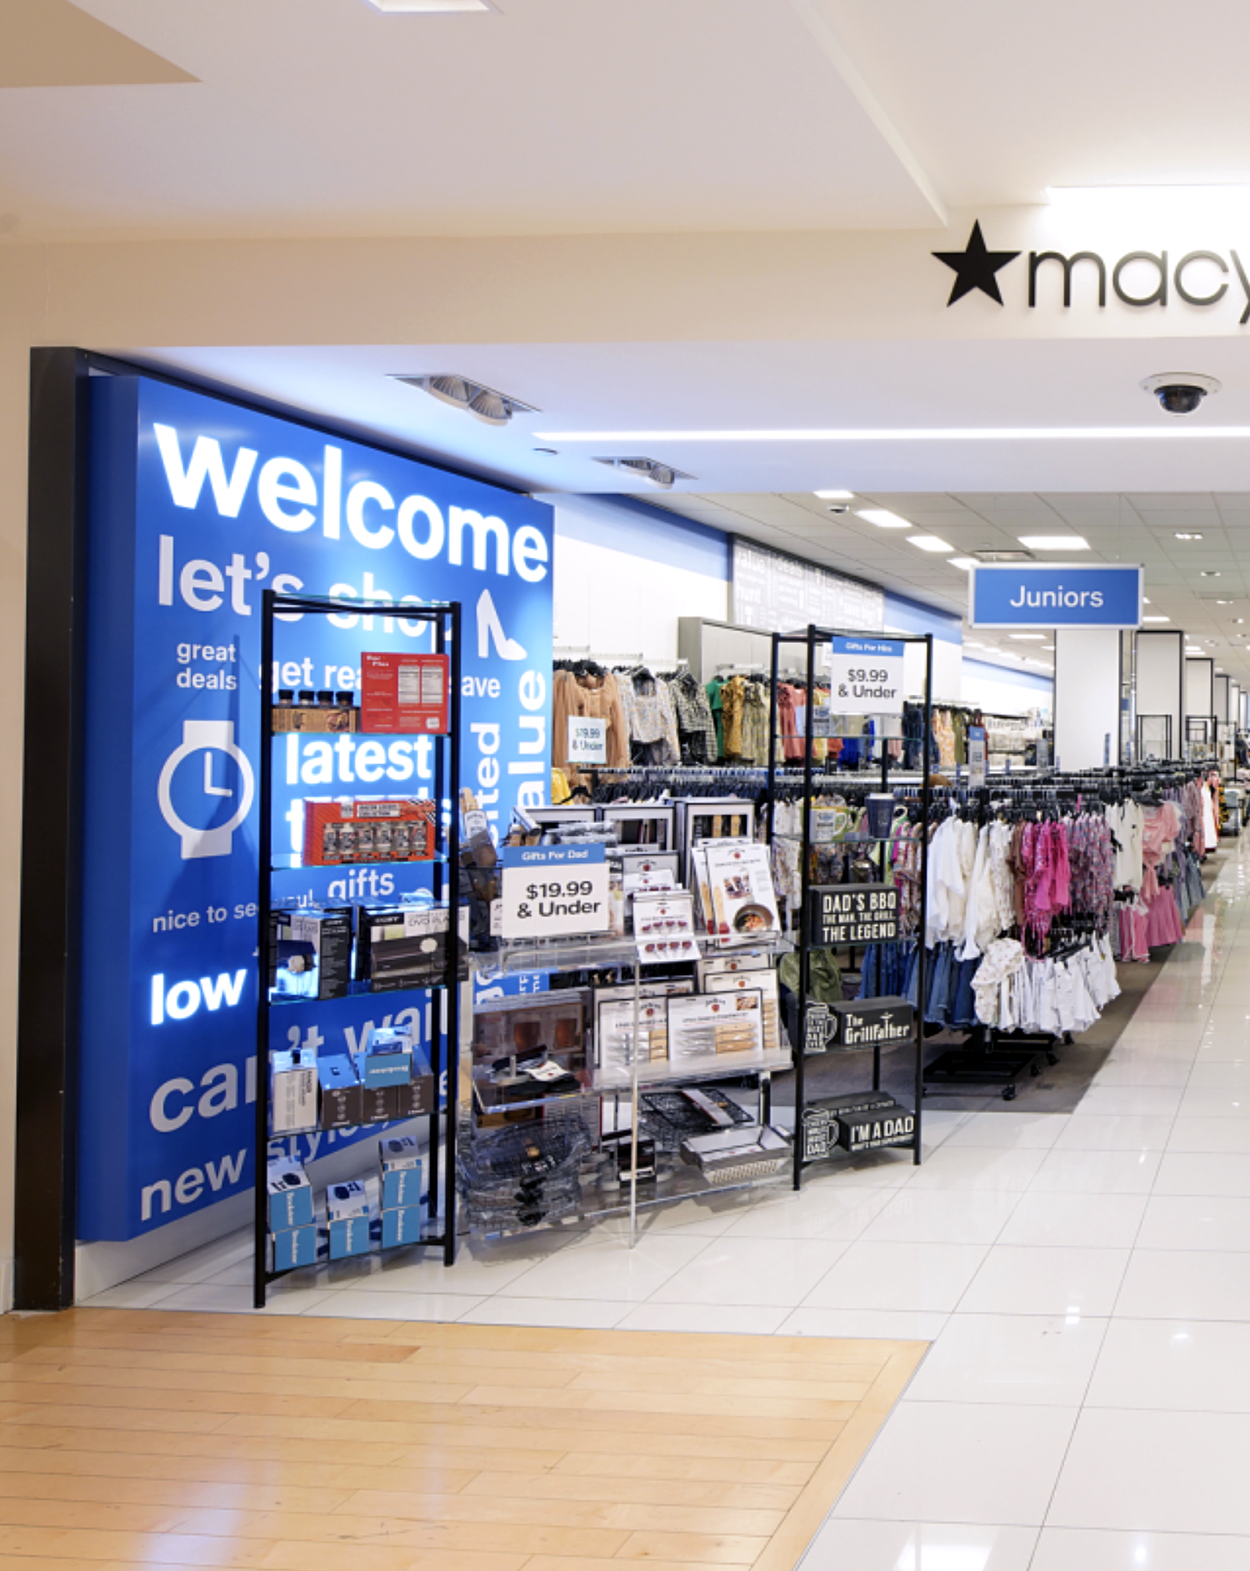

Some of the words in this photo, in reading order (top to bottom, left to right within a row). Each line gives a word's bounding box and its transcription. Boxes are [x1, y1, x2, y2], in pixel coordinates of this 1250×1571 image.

[153, 422, 549, 583] welcome
[1009, 585, 1104, 608] Juniors
[176, 642, 237, 664] great
[864, 643, 876, 651] For
[176, 667, 238, 690] deals
[848, 668, 888, 683] $9.99
[838, 683, 848, 698] &
[852, 685, 897, 699] Under
[285, 733, 433, 786] latest
[521, 851, 546, 861] Gifts
[549, 851, 565, 860] For
[568, 849, 588, 859] Dad
[526, 880, 593, 900] $19.99
[517, 902, 532, 919] &
[539, 900, 602, 918] Under
[823, 893, 865, 914] DAD'S
[870, 891, 897, 910] BBQ
[153, 910, 201, 934] nice
[206, 906, 228, 924] to
[823, 925, 848, 943] THE
[850, 922, 896, 941] LEGEND
[150, 969, 248, 1026] low
[845, 1011, 910, 1045] Grillfather
[846, 1013, 864, 1027] The
[851, 1123, 870, 1143] I'M
[872, 1121, 882, 1139] A
[883, 1116, 915, 1137] DAD
[140, 1149, 247, 1221] new
